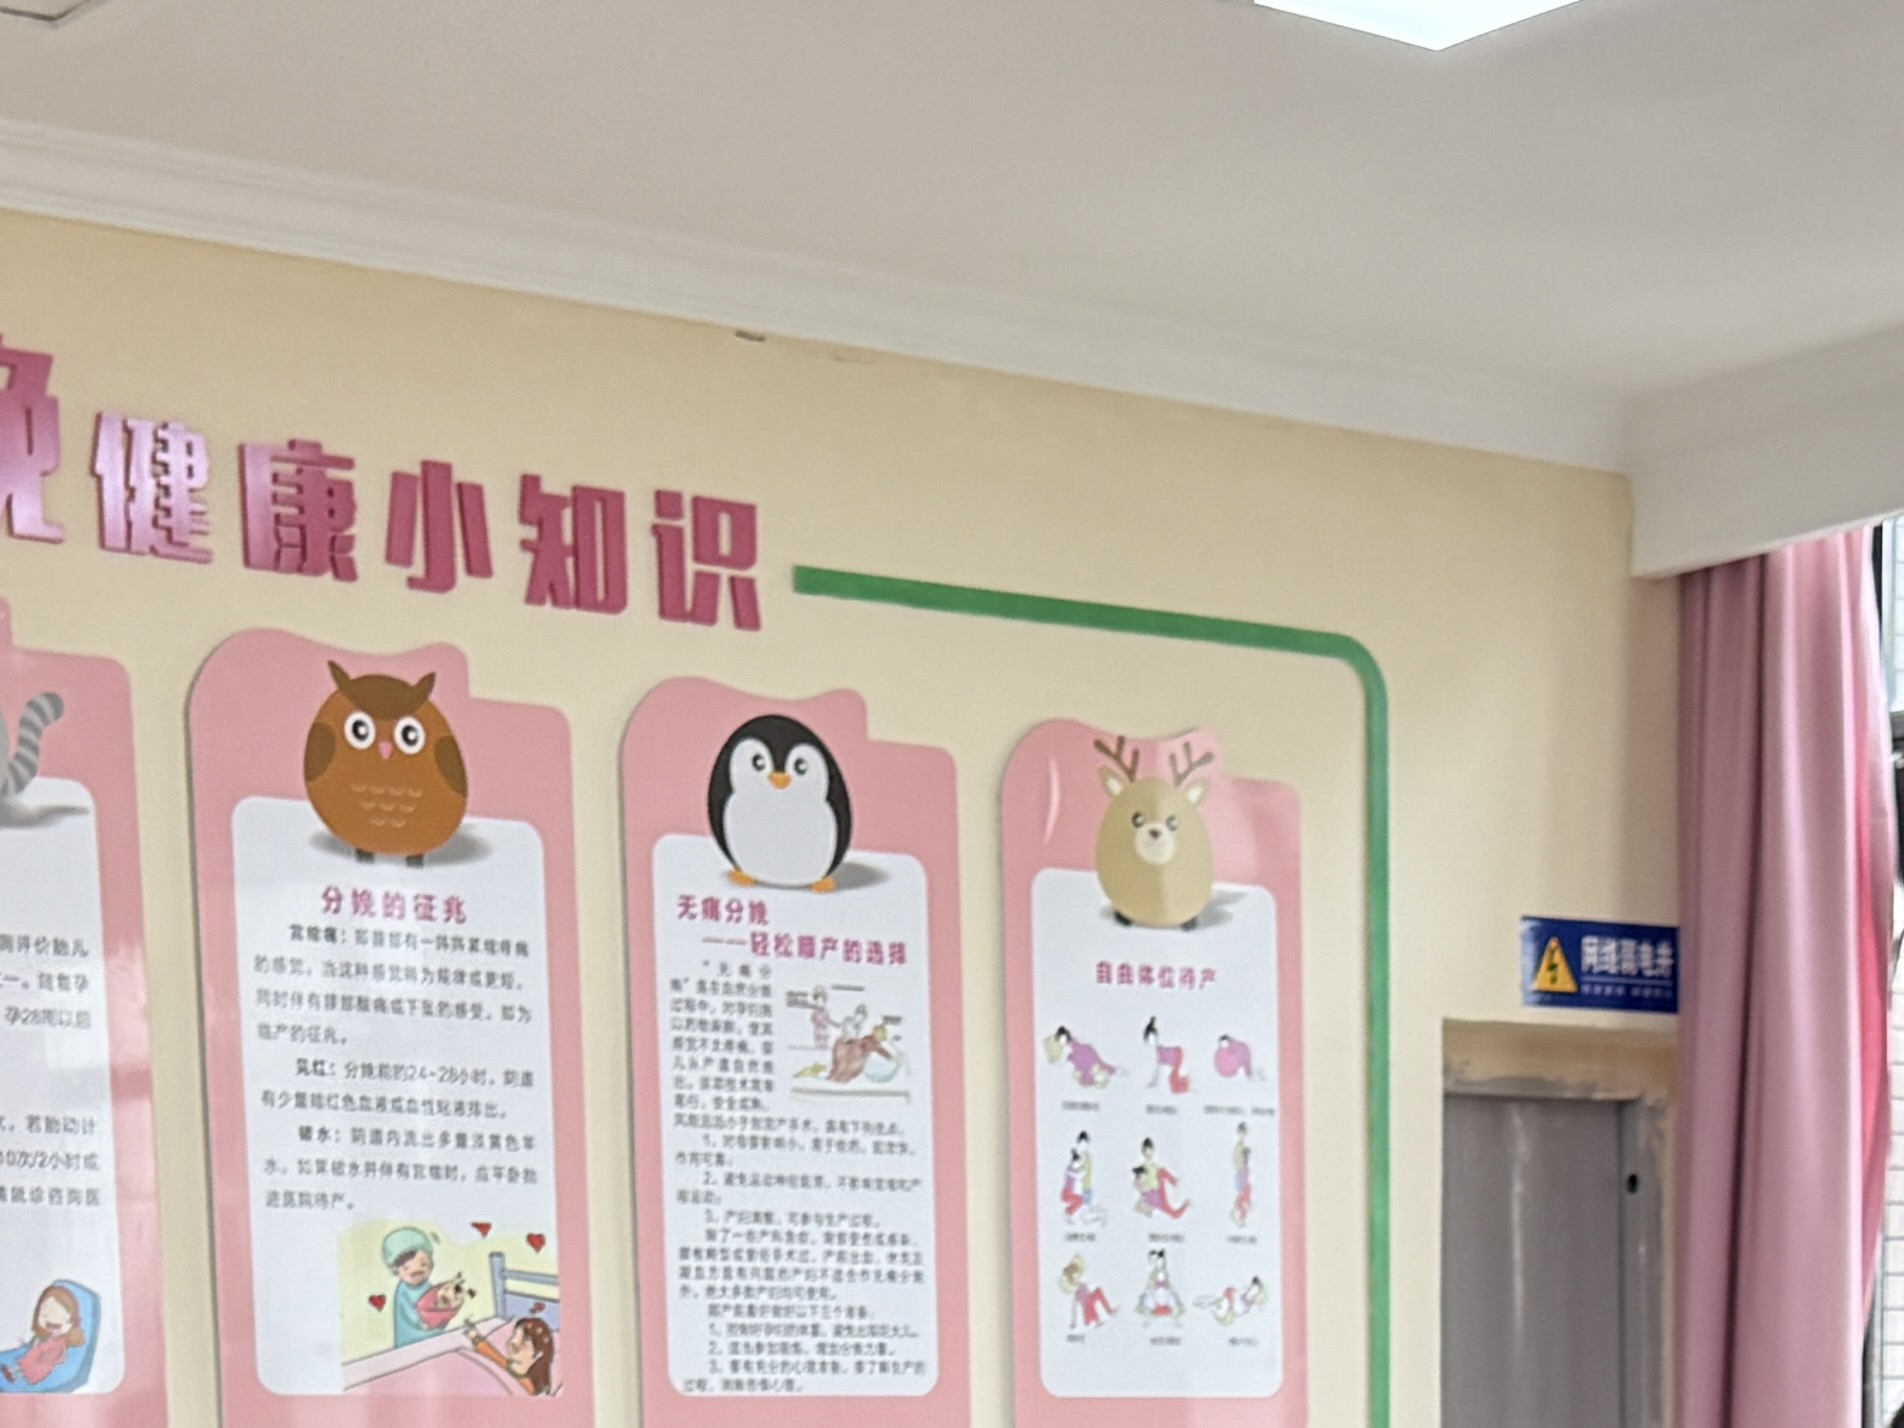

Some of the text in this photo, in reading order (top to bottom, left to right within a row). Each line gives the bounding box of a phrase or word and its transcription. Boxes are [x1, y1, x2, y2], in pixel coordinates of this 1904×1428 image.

[321, 885, 468, 924] 分娩的征兆
[677, 894, 770, 926] 无痛分娩
